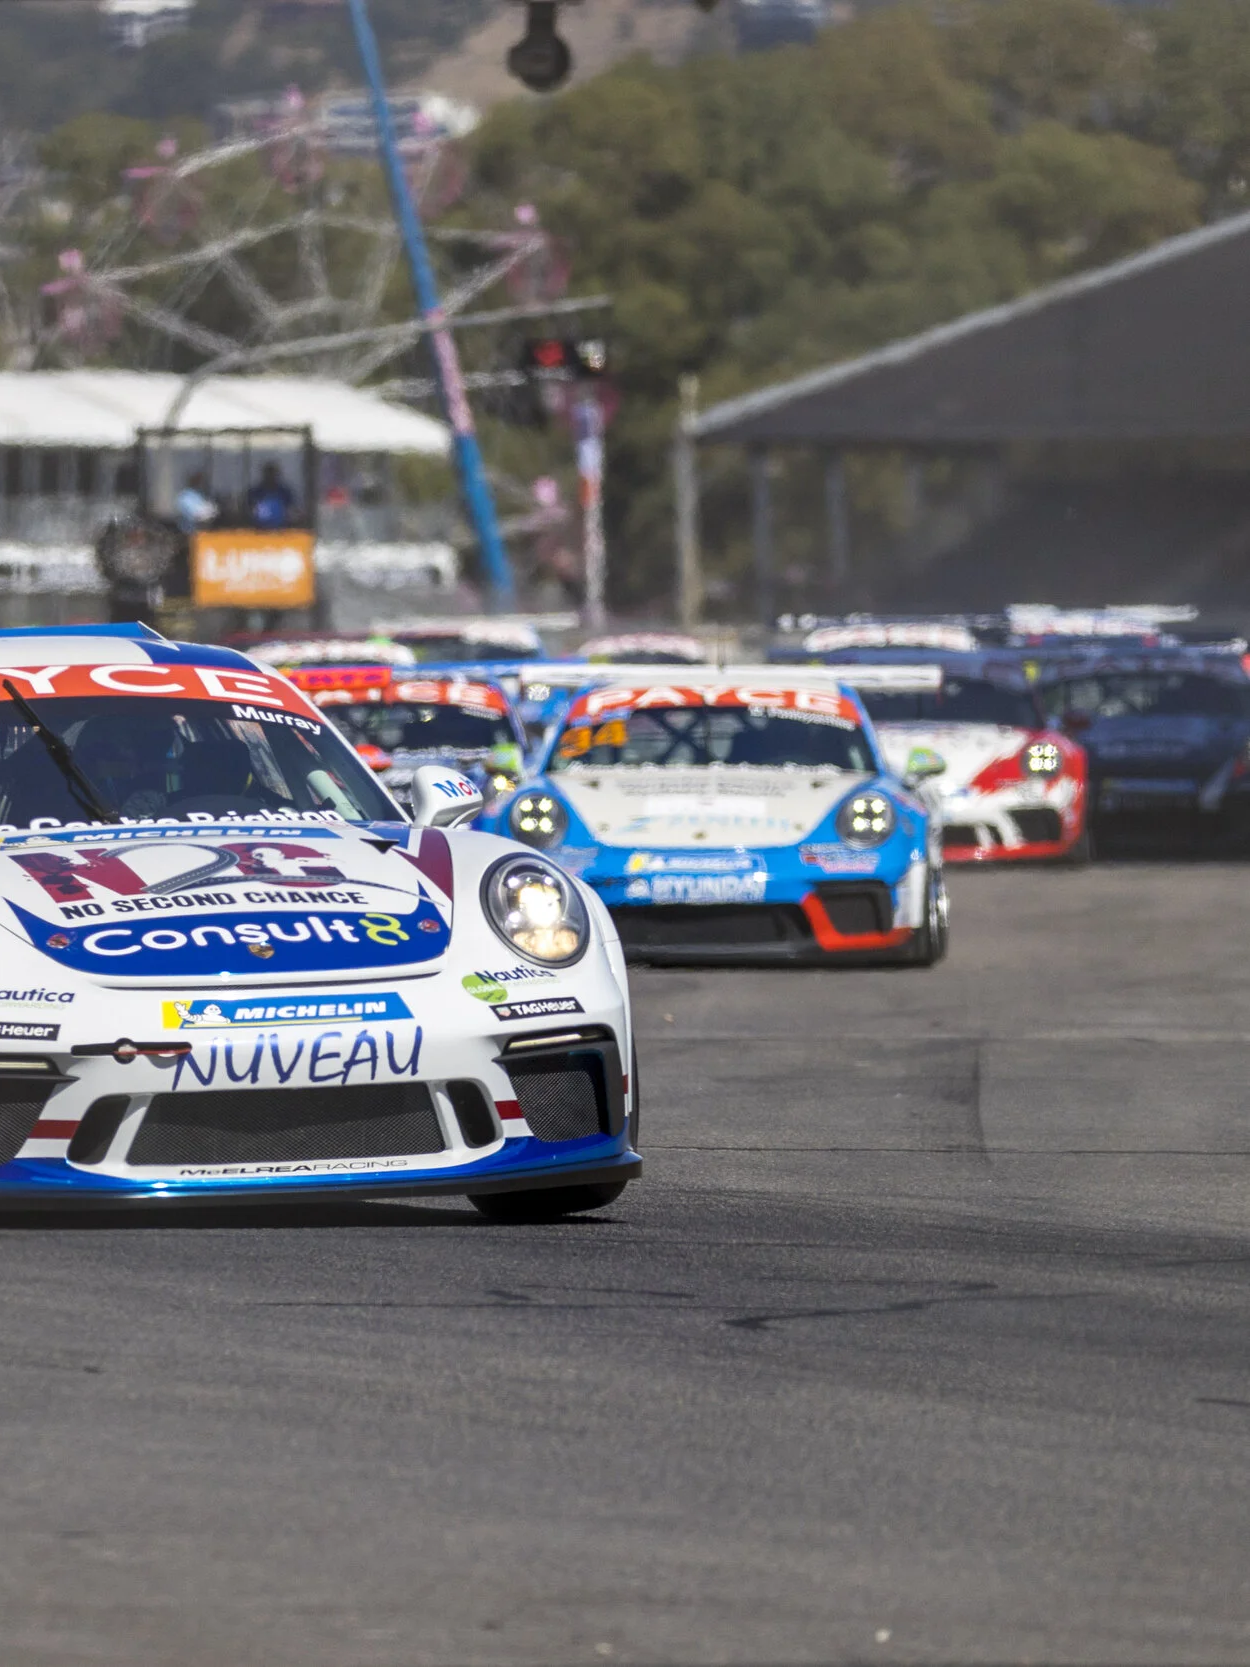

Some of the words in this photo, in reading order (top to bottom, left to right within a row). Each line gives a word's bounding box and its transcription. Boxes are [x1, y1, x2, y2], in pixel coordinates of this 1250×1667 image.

[232, 704, 322, 736] Murray
[60, 902, 104, 920] NO
[114, 893, 237, 913] SECOND
[249, 891, 369, 906] CHANCE
[474, 964, 557, 984] Nautica
[234, 1000, 388, 1022] MICHELIN
[170, 1025, 423, 1091] NUVEAU
